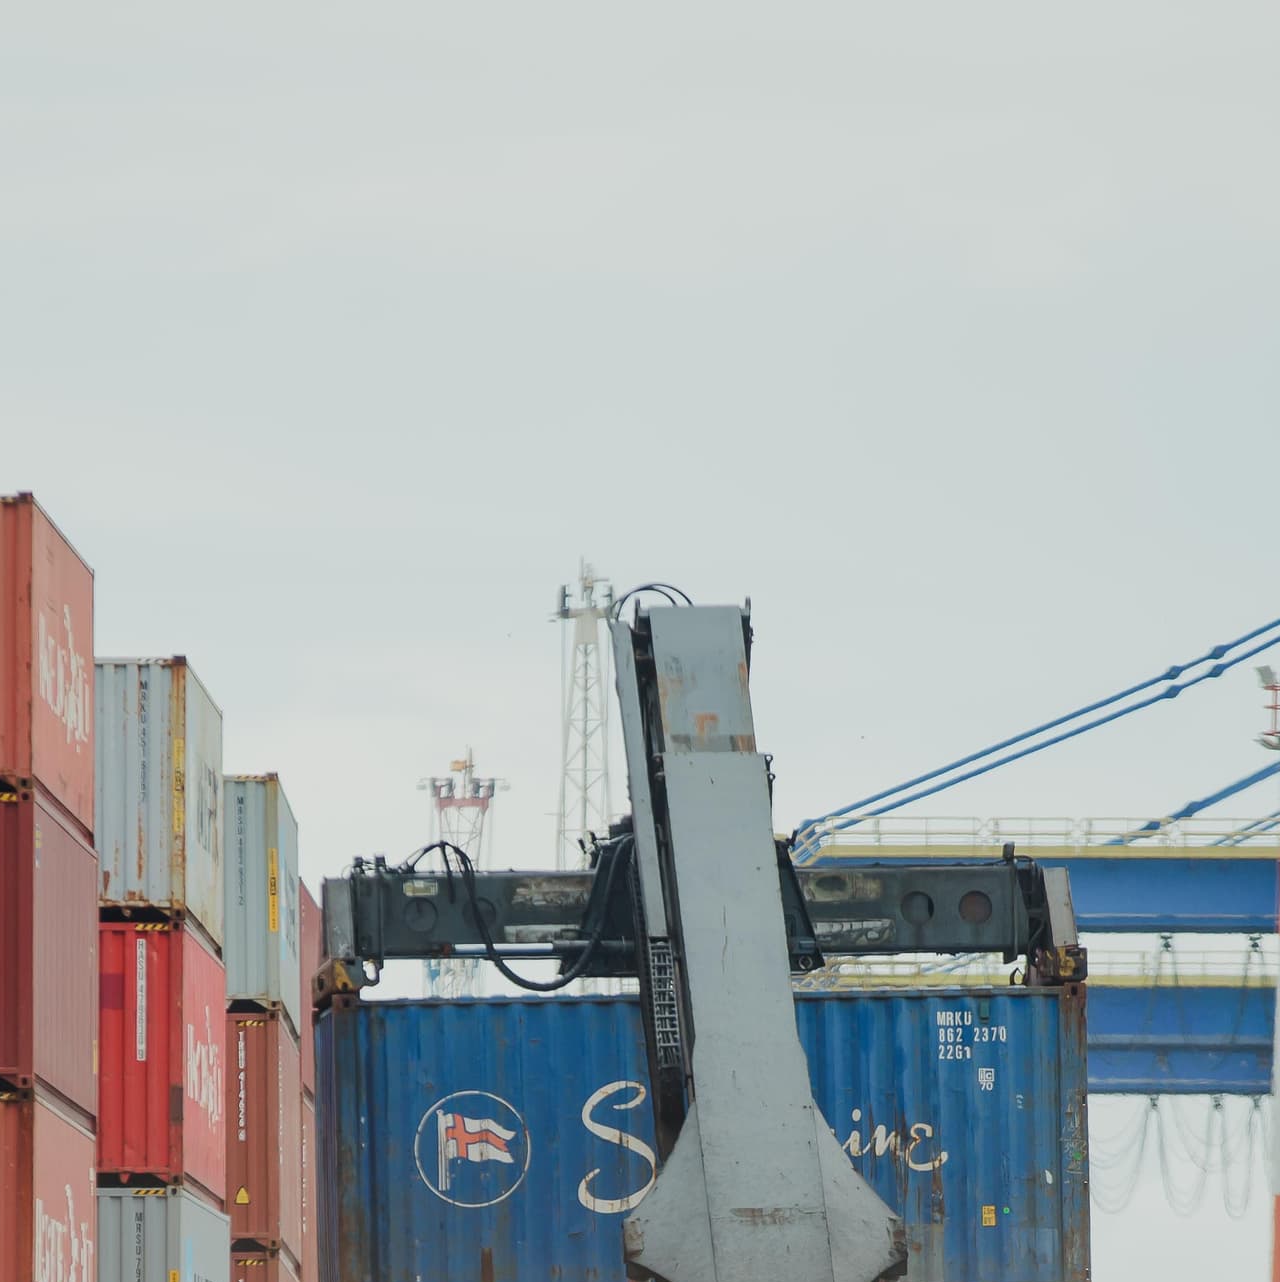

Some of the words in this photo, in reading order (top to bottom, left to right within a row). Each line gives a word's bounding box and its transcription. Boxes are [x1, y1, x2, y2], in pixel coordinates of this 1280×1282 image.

[937, 1011, 972, 1026] MRKU
[939, 1028, 963, 1042] 862
[973, 1026, 1007, 1042] 2370
[938, 1045, 971, 1060] 22G1
[980, 1082, 993, 1091] 70
[135, 1212, 143, 1255] MRSU
